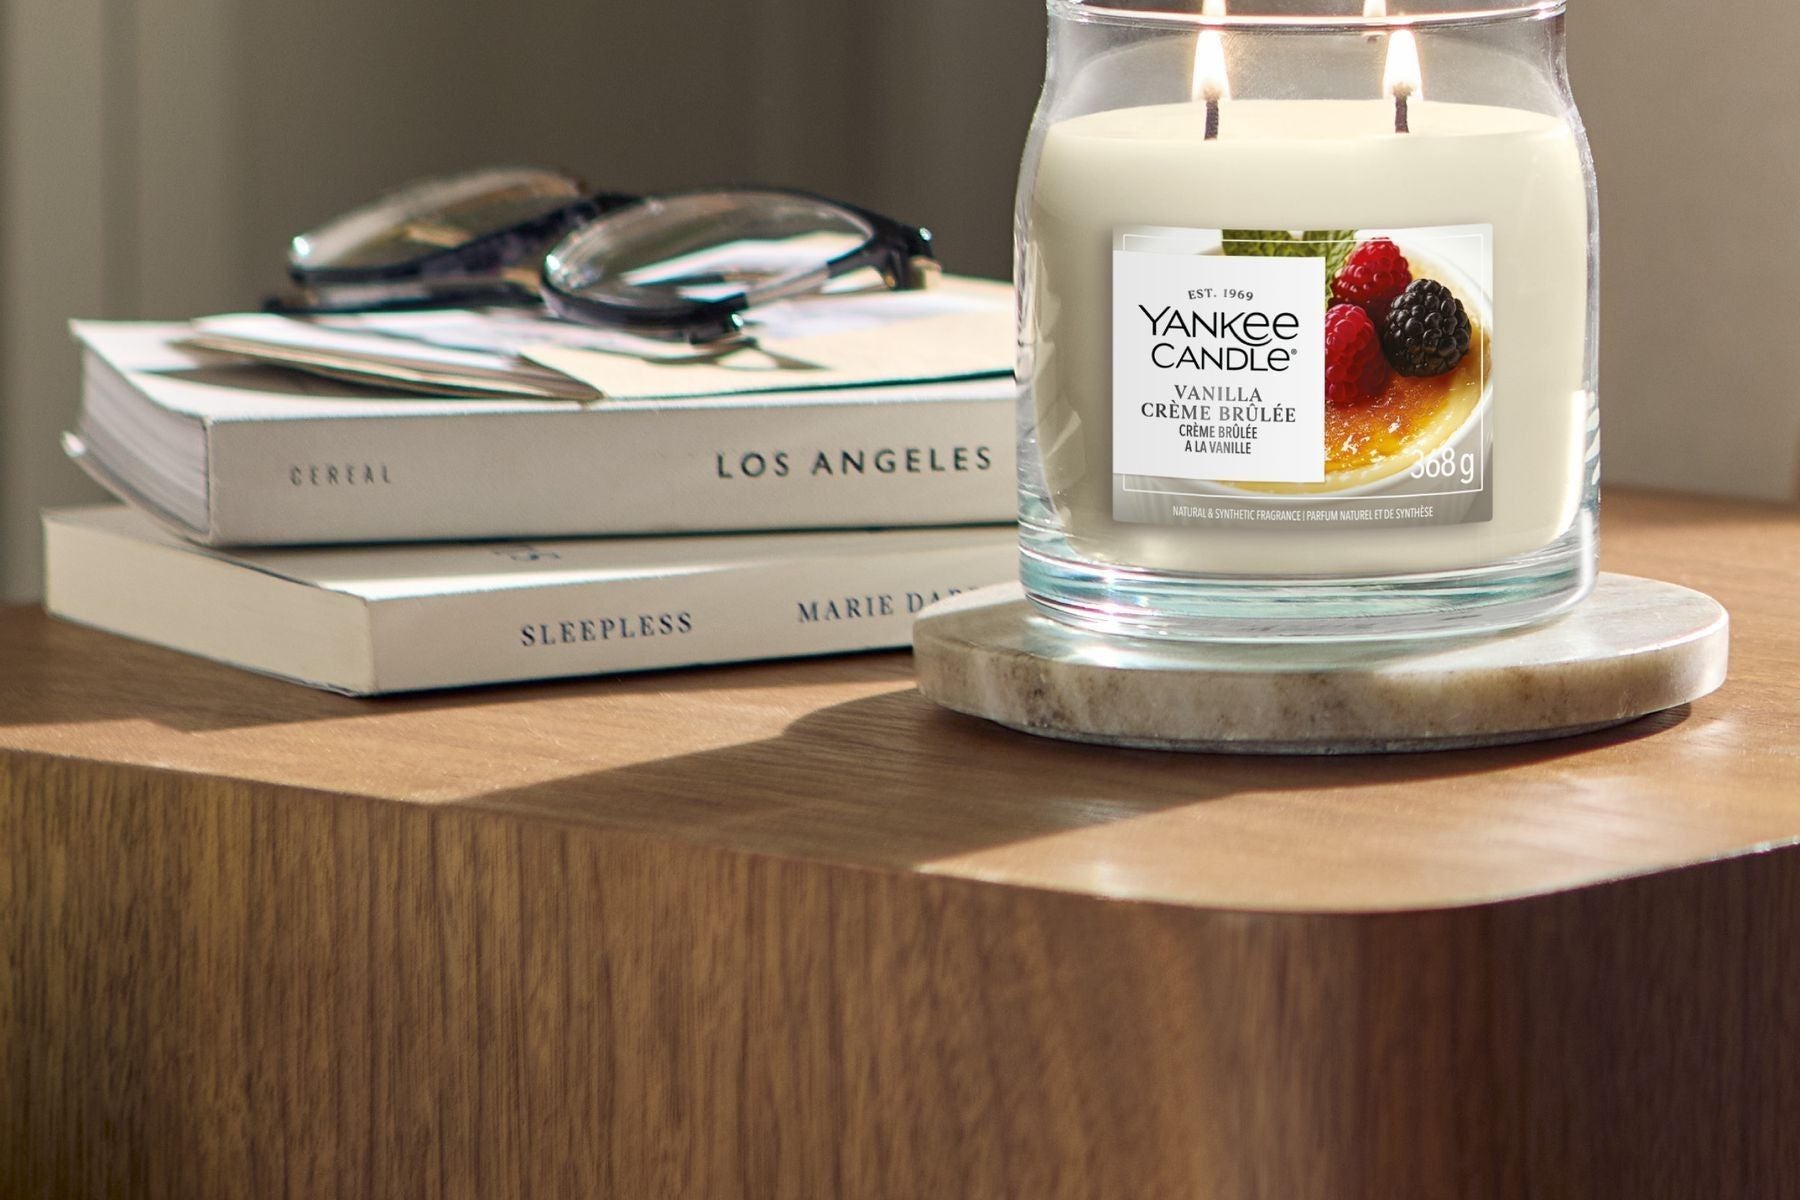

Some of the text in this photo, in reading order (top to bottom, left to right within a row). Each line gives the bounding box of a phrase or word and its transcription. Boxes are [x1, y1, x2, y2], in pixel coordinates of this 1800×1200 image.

[1188, 288, 1254, 301] EST. 1969
[1174, 384, 1263, 402] VANILLA
[1141, 400, 1296, 423] CRÈME BRÛLÉE
[1179, 422, 1258, 439] CRÈME BRÛLÉE
[1184, 440, 1252, 454] A LA VANILLE
[717, 446, 992, 479] LOS ANGELES
[1460, 453, 1474, 484] g
[289, 463, 391, 486] CEREAL
[1173, 505, 1433, 521] NATURAL & SYNTHETIC FRAGRANCE PARFUM NATUREL ET DE SYNTHÈSE
[798, 594, 894, 623] MARIE
[520, 612, 692, 647] SLEEPLESS
